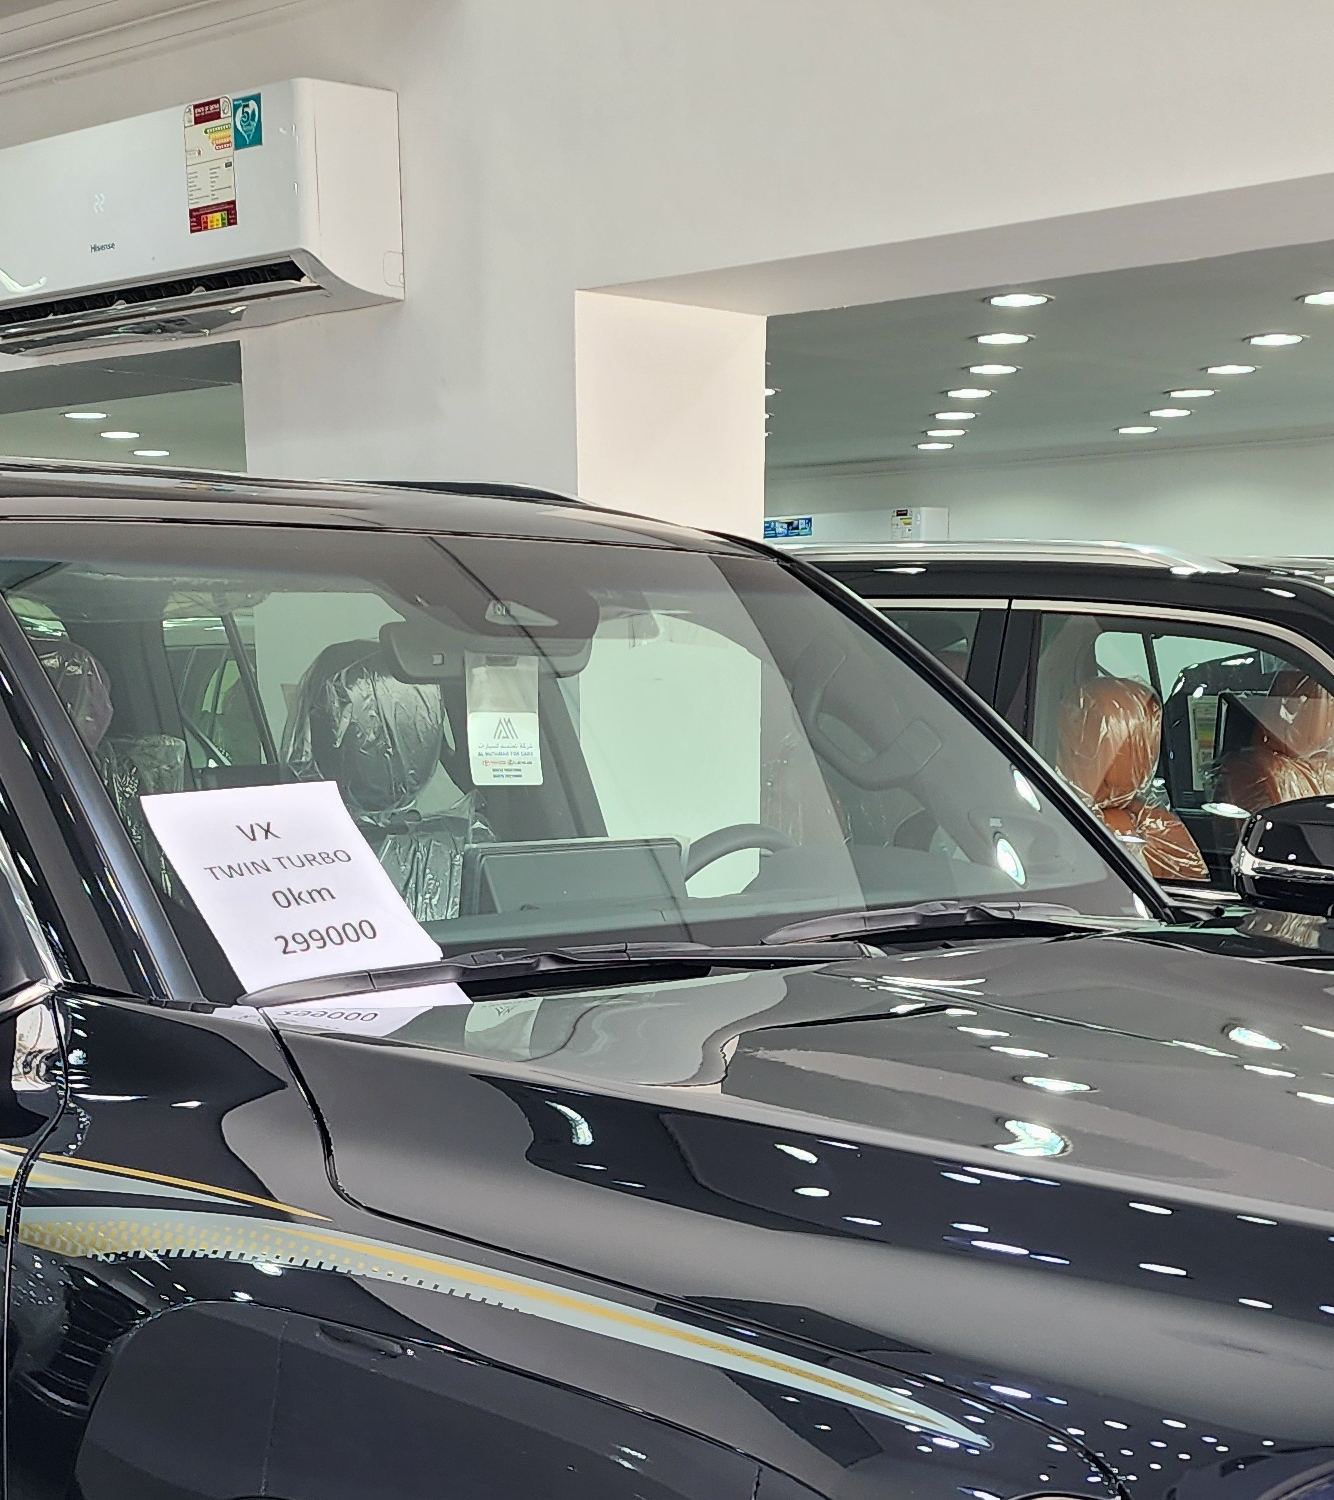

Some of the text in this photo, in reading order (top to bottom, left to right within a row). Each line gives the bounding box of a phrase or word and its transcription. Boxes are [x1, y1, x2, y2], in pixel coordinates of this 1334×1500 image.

[89, 242, 116, 253] Hisense
[235, 822, 281, 842] VX
[203, 849, 352, 881] TWIN TURBO
[271, 886, 336, 909] 0km
[274, 919, 377, 955] 299000
